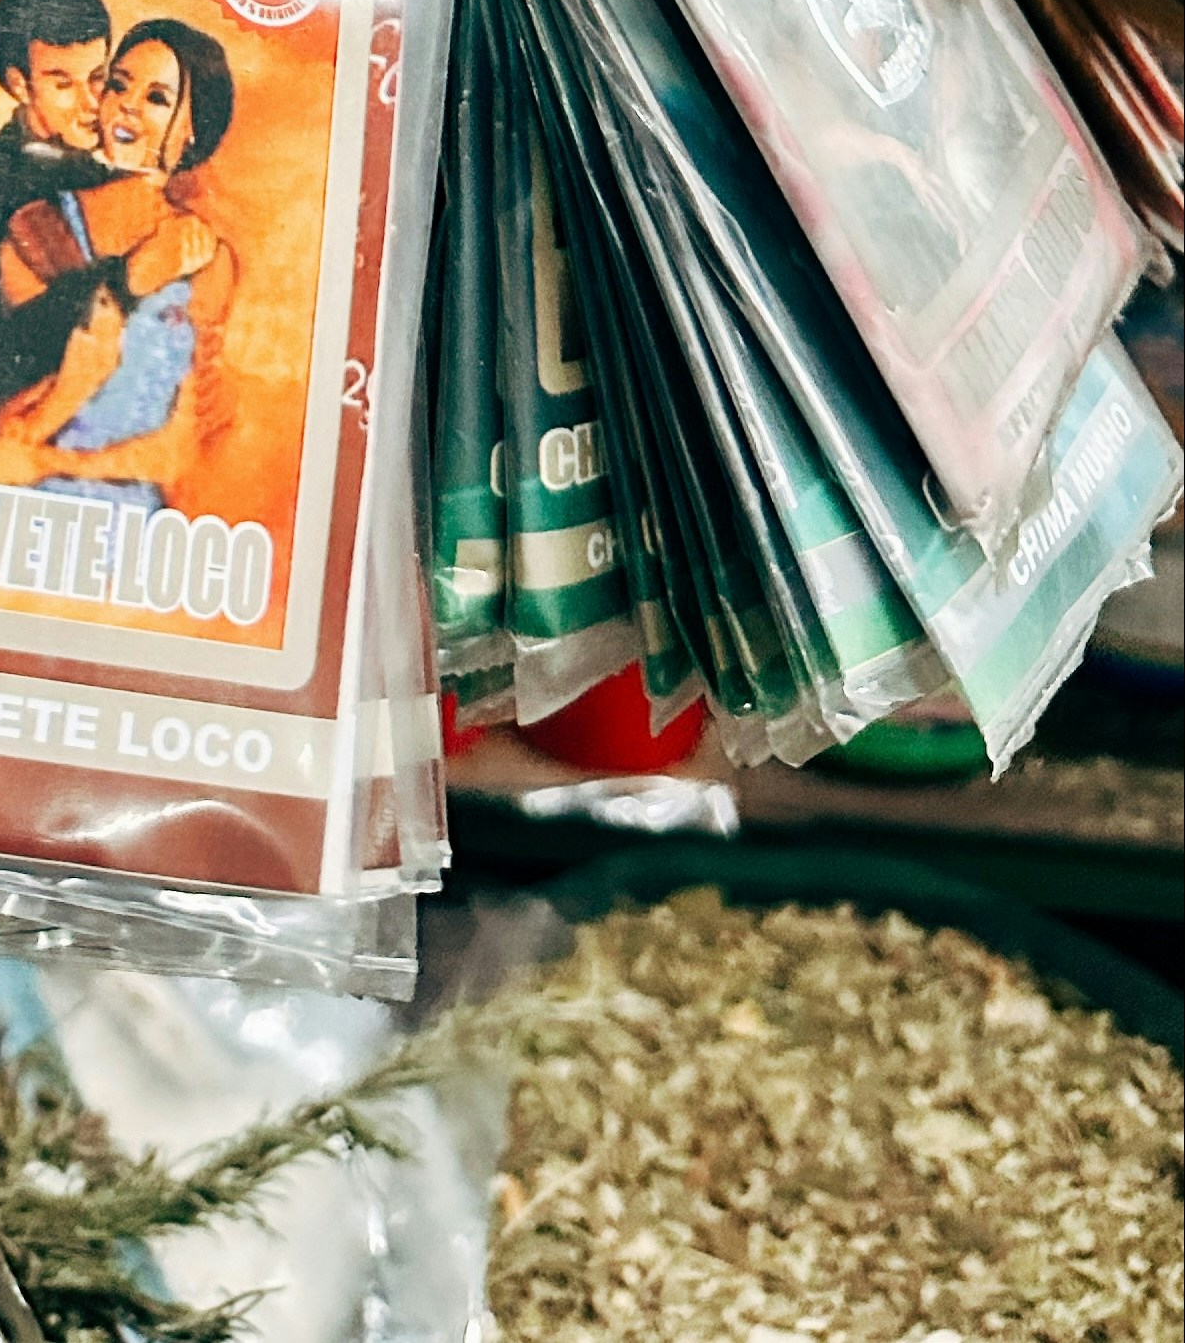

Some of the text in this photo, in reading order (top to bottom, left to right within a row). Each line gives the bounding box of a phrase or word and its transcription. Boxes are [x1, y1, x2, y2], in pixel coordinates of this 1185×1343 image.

[1068, 401, 1134, 504] MUCHO
[116, 503, 274, 625] LOCO
[116, 710, 274, 775] LOCO
